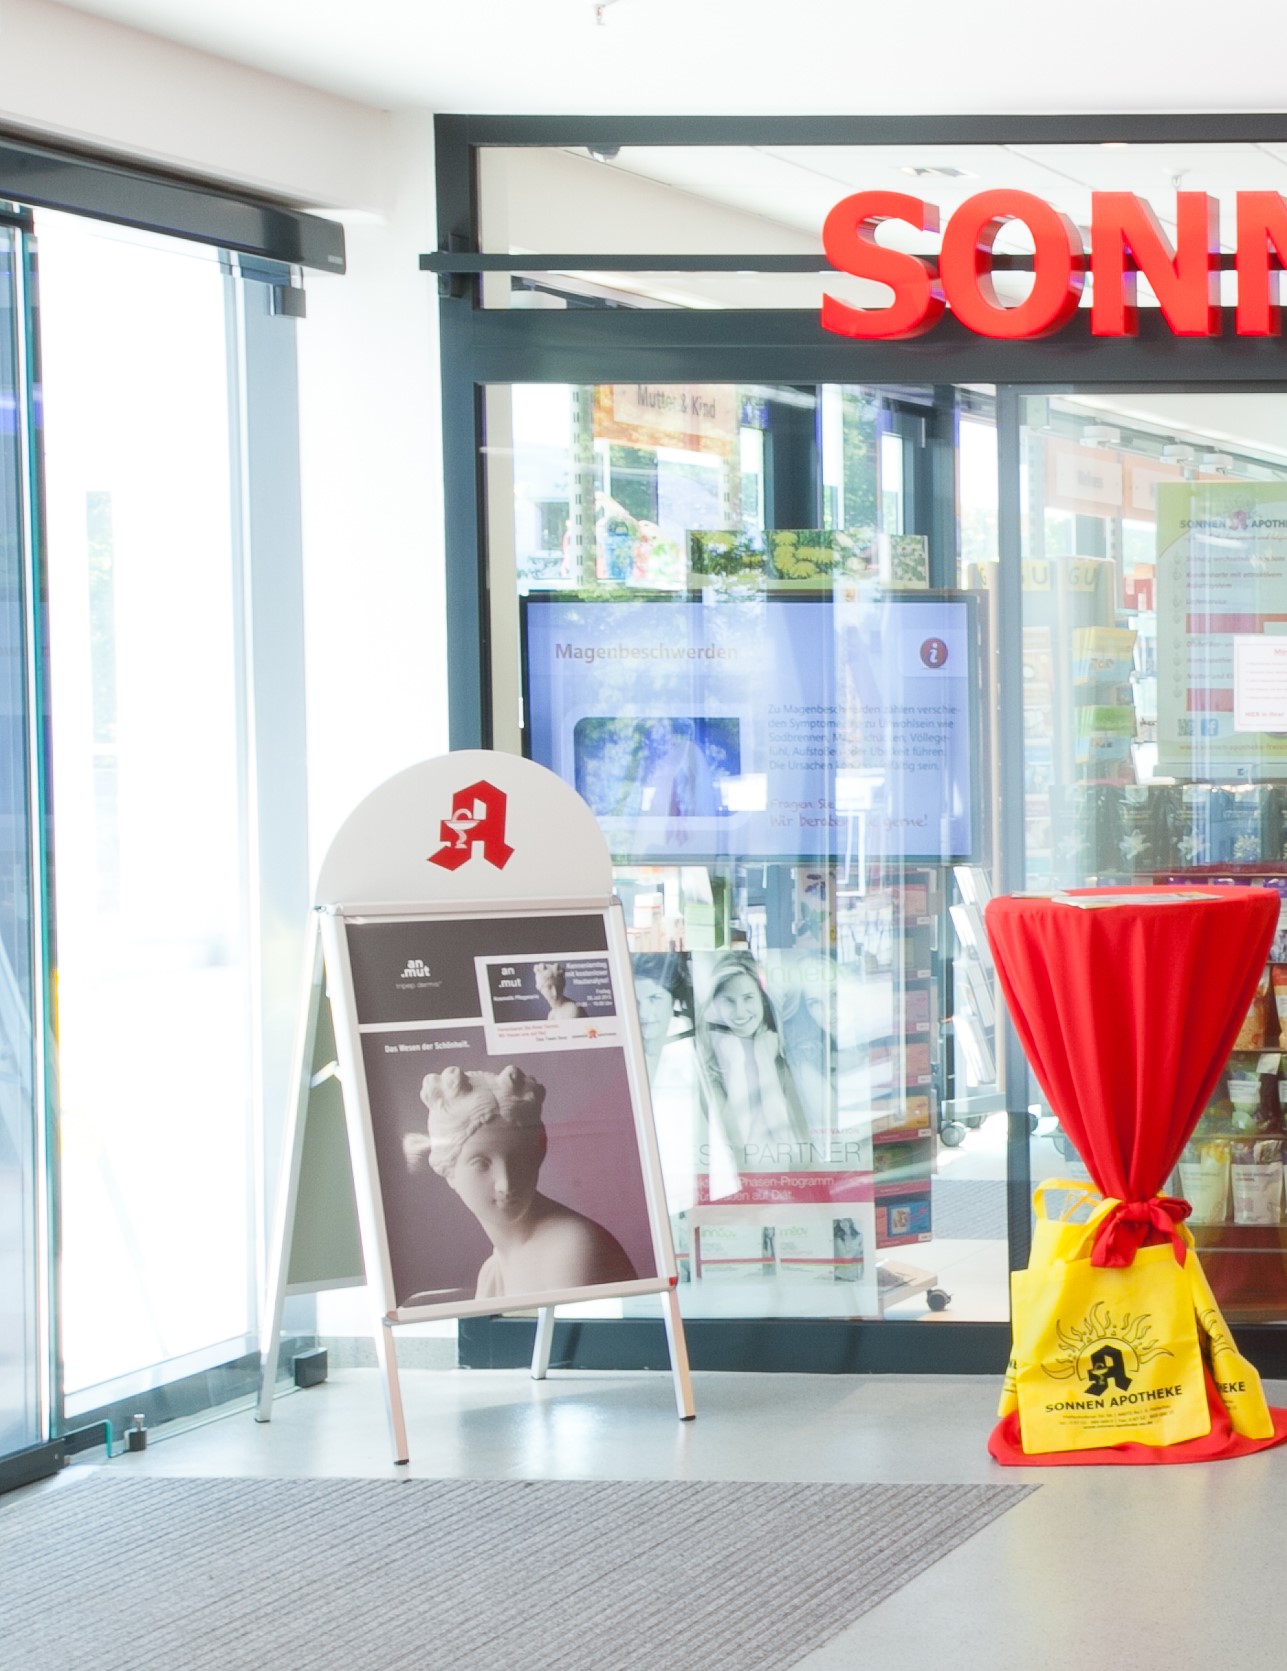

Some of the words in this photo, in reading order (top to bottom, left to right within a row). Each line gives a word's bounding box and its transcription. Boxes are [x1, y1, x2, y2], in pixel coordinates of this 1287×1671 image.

[690, 394, 716, 419] Kind
[1179, 519, 1226, 529] SONNEN
[555, 642, 738, 665] Magenbeschwerden
[501, 966, 515, 976] an
[384, 1044, 399, 1054] Das
[398, 1043, 421, 1053] Wesen
[421, 1042, 434, 1052] der
[434, 1040, 471, 1050] Schönheit.
[744, 1141, 861, 1164] PARTNER
[1045, 1398, 1105, 1413] SONNEN
[1110, 1384, 1183, 1408] APOTHEKE
